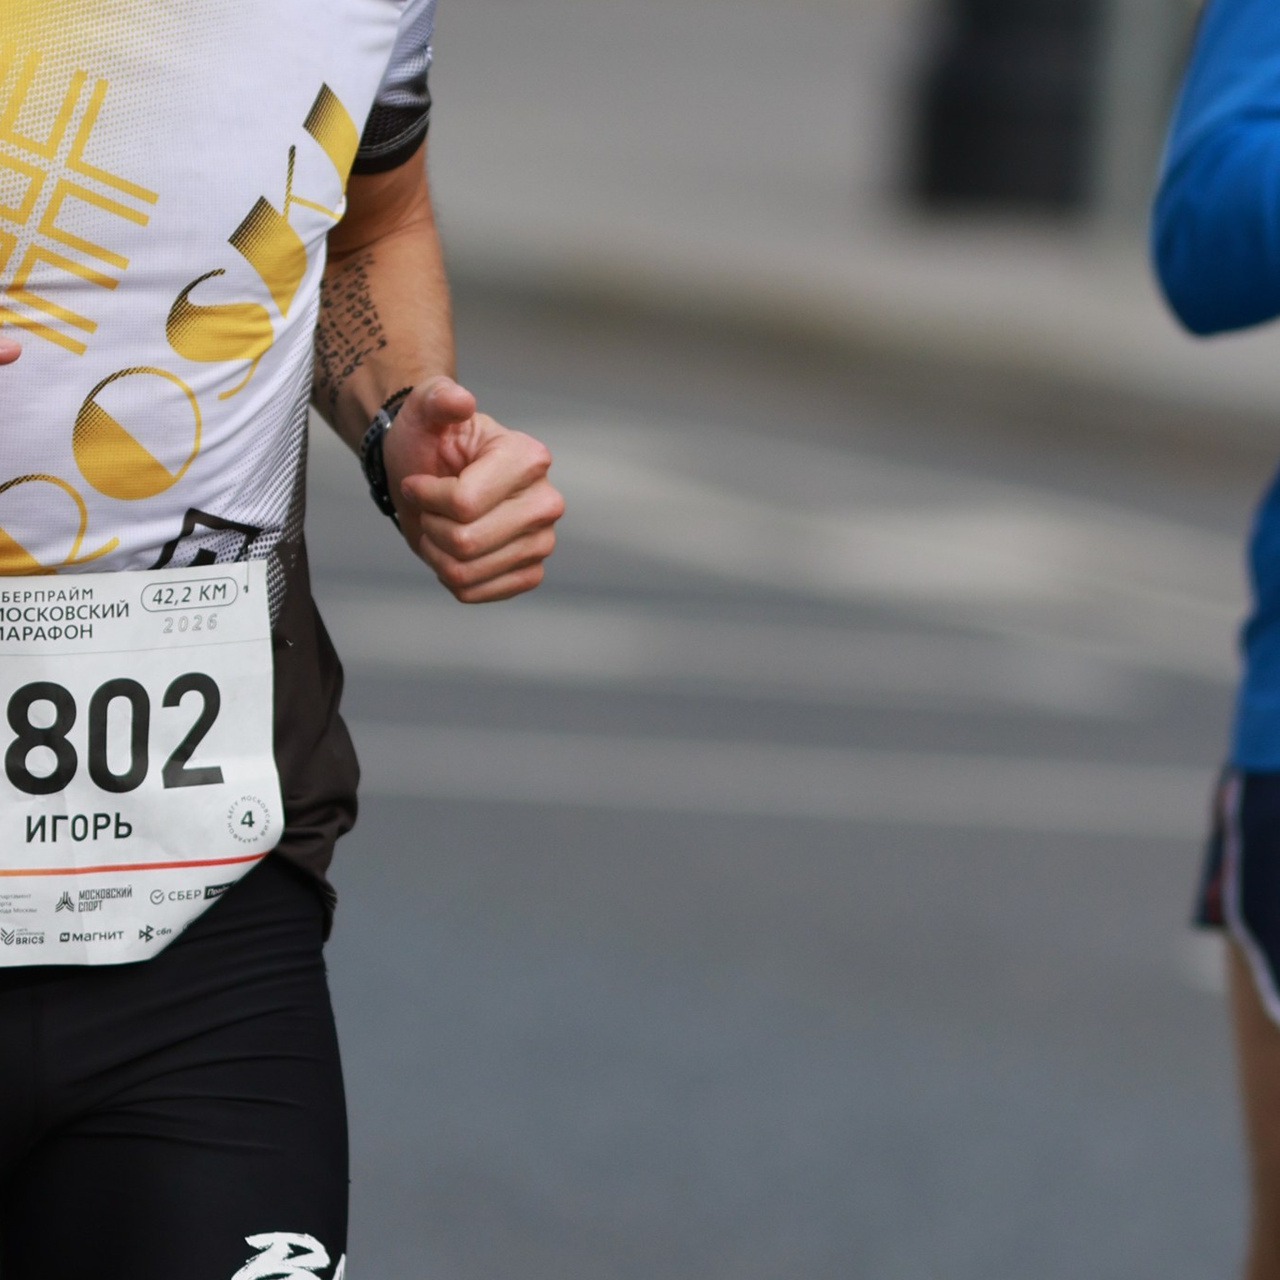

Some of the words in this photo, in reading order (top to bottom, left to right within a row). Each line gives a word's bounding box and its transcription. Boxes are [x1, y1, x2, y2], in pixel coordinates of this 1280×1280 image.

[152, 586, 192, 606] 42,2
[199, 583, 227, 602] КМ
[162, 613, 218, 634] 2026
[25, 812, 133, 843] ИГОРЬ
[240, 810, 255, 828] 4
[78, 885, 133, 901] МОСКОВСКИЙ
[168, 889, 202, 902] СБЕР
[78, 900, 103, 912] СПОРТ
[16, 936, 45, 945] BRICS
